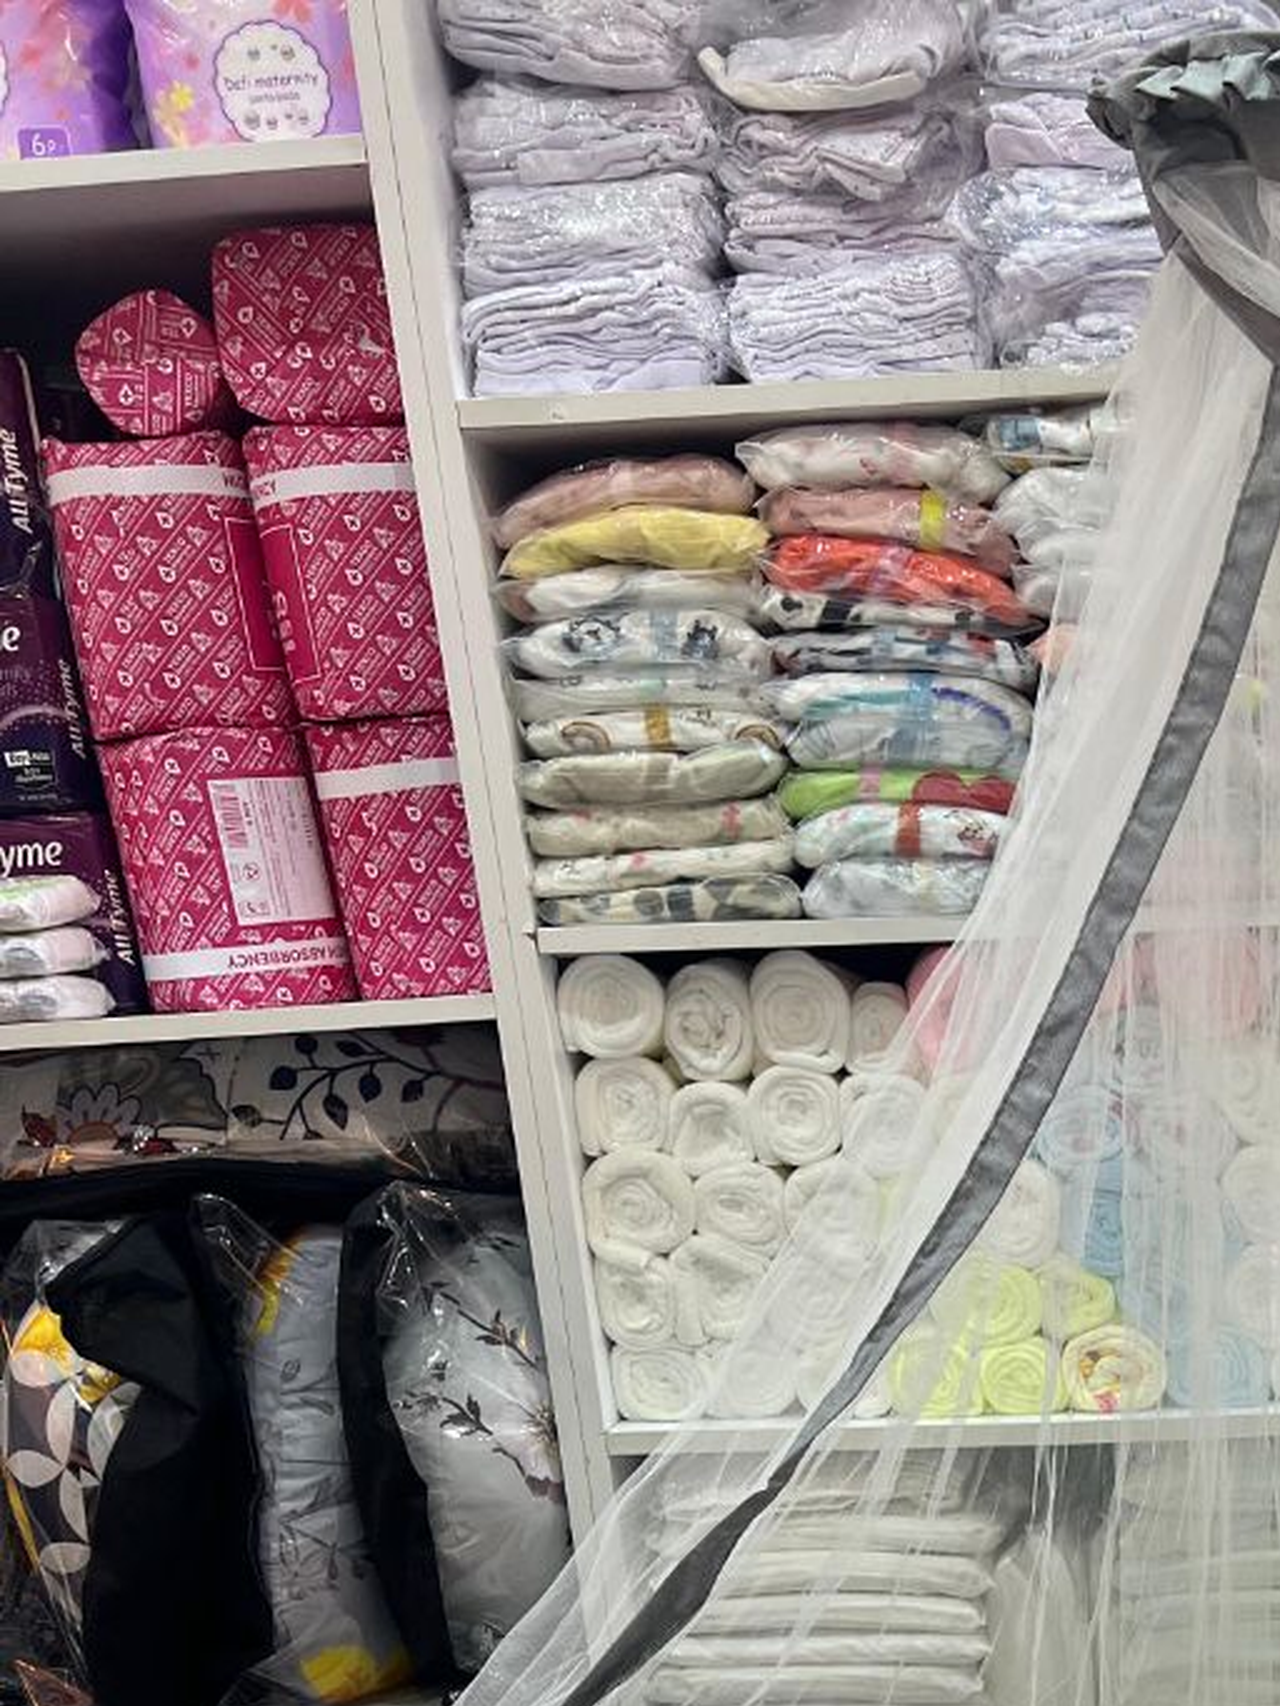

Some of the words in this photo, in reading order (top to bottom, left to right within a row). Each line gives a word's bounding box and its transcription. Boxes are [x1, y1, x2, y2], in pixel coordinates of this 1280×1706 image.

[0, 428, 28, 494] Tyme
[10, 500, 33, 534] All
[0, 840, 63, 878] yme
